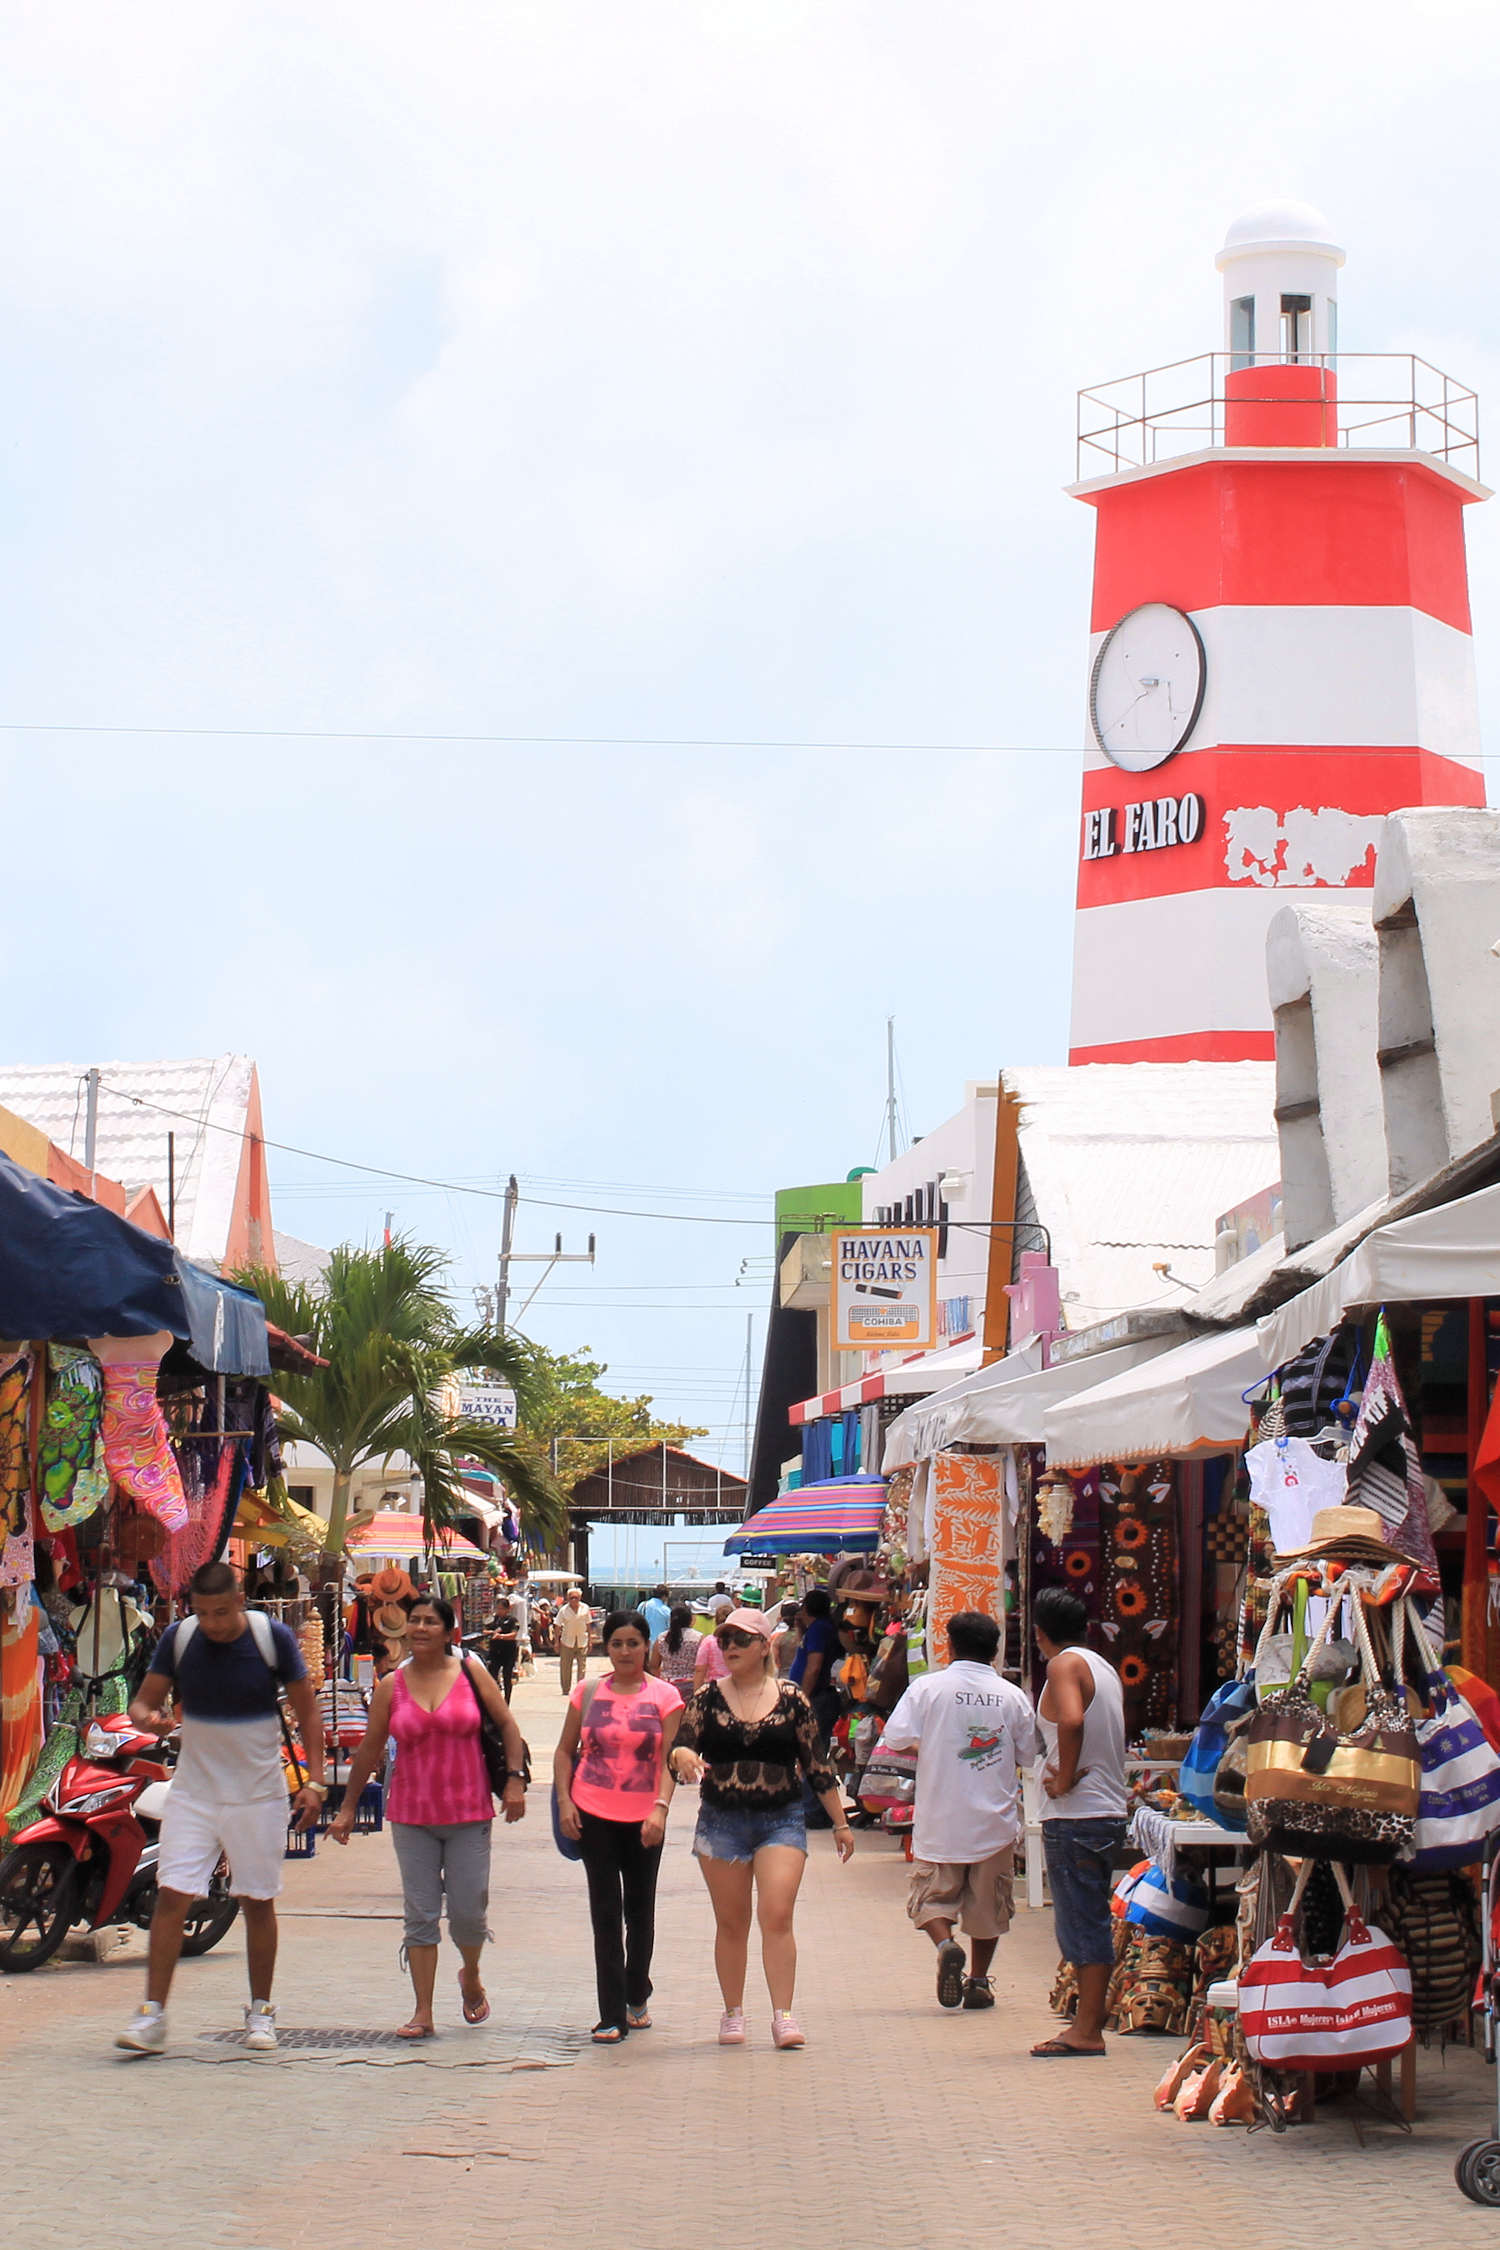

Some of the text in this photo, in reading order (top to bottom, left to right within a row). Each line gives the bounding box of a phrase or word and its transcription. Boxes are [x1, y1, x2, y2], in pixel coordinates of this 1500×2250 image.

[1082, 792, 1201, 860] EL FARO
[841, 1240, 924, 1260] HAVANA
[841, 1262, 917, 1281] CIGARS
[864, 1318, 903, 1326] COHIBA
[461, 1403, 514, 1414] MAYAN
[955, 1691, 1004, 1707] STAFF
[1267, 2015, 1292, 2028] ISLA
[1300, 2014, 1330, 2026] Mujeres
[1361, 2003, 1393, 2018] Mujeres
